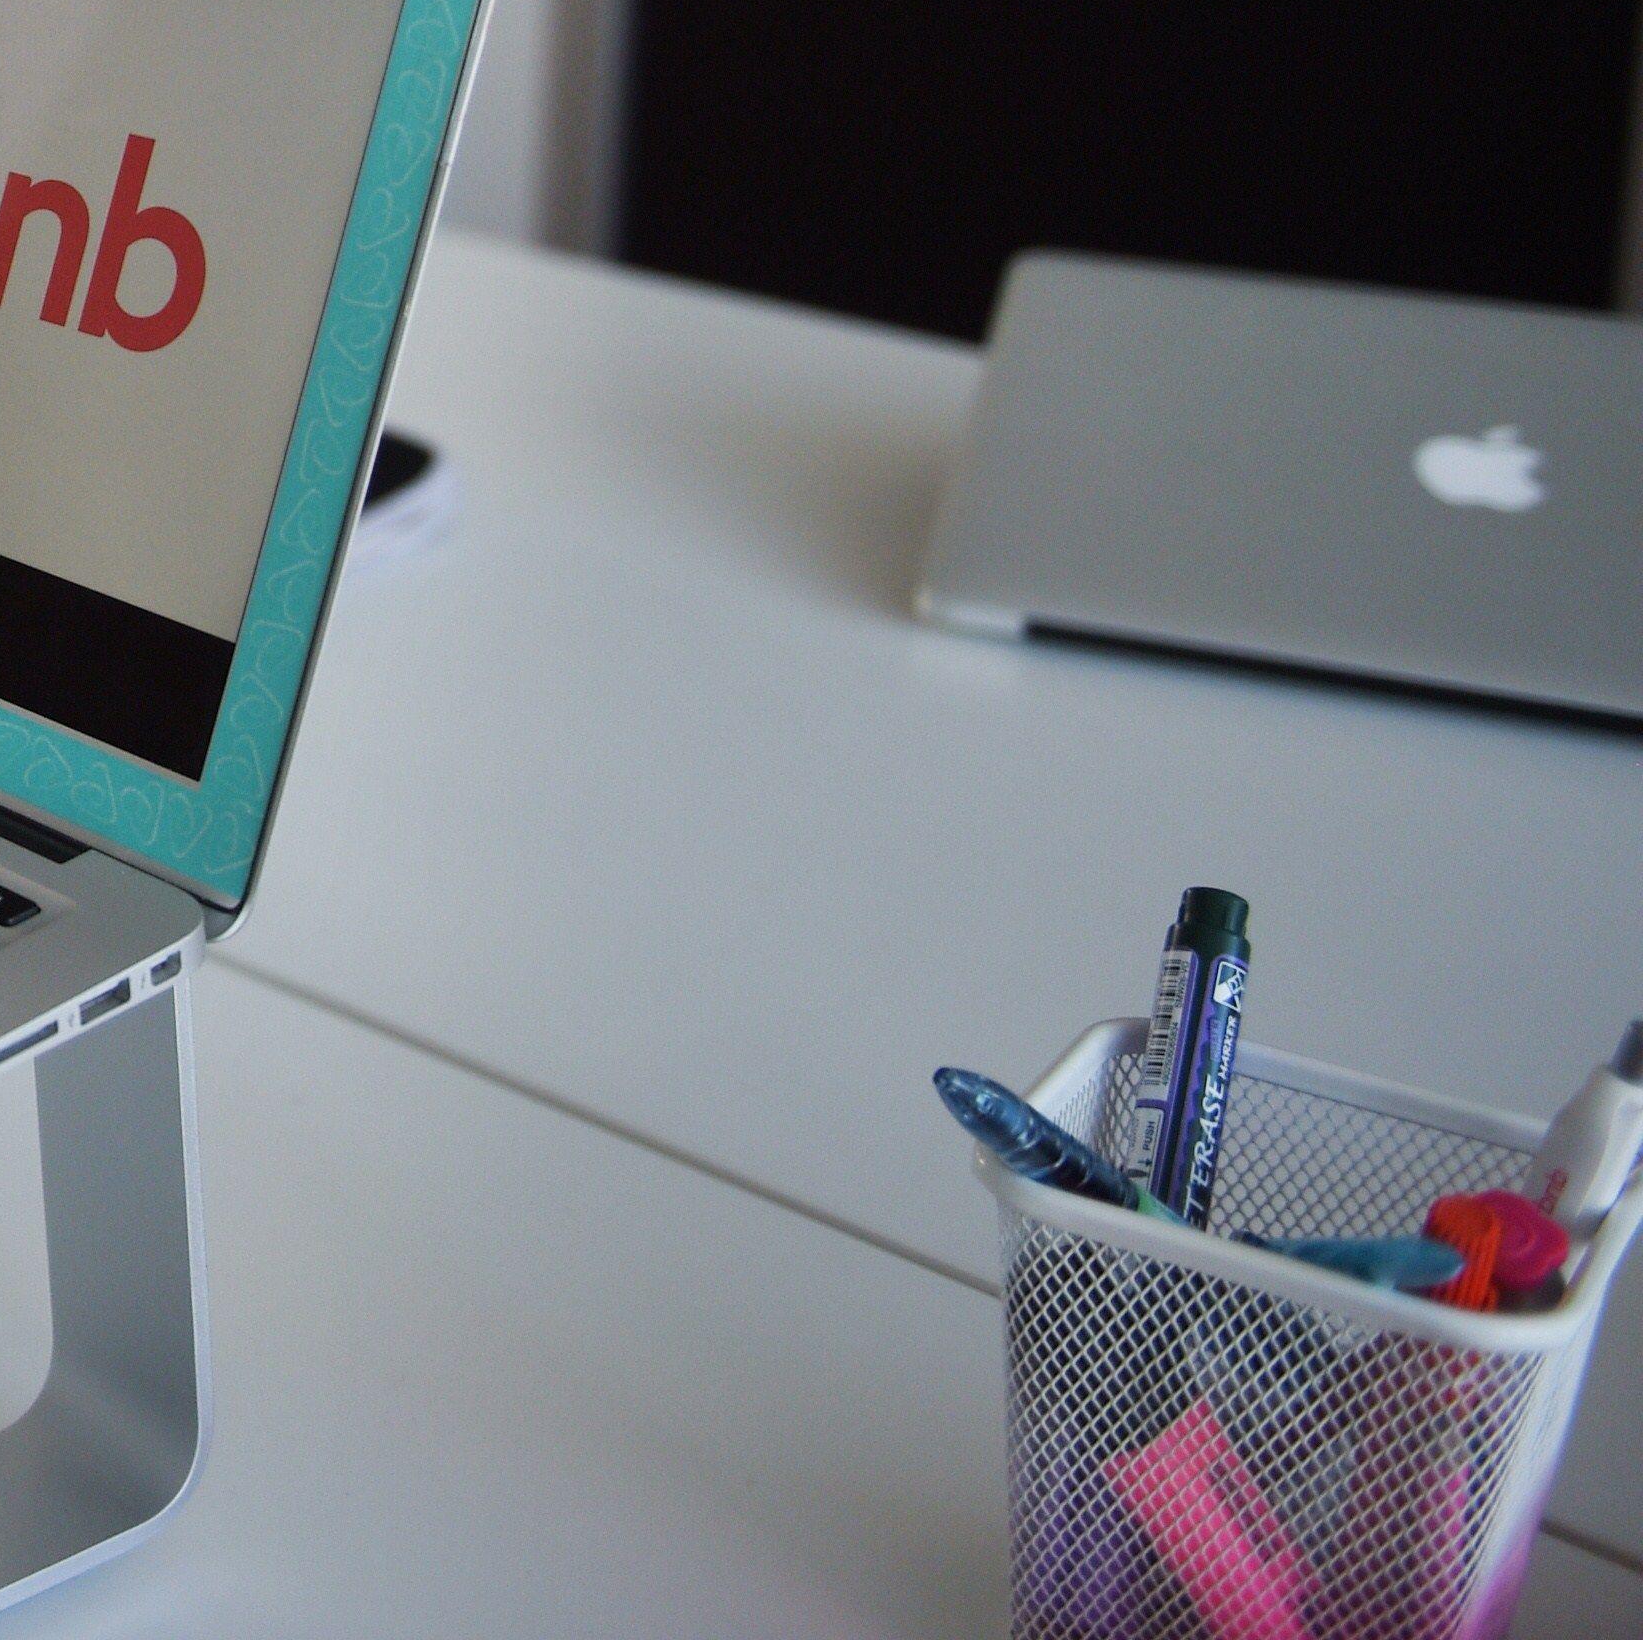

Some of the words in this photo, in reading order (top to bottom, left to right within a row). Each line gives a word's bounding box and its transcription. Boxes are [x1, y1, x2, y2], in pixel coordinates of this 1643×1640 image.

[1142, 1120, 1157, 1152] PUSH
[1191, 1073, 1225, 1188] ERASE
[1217, 1014, 1240, 1080] MARKER
